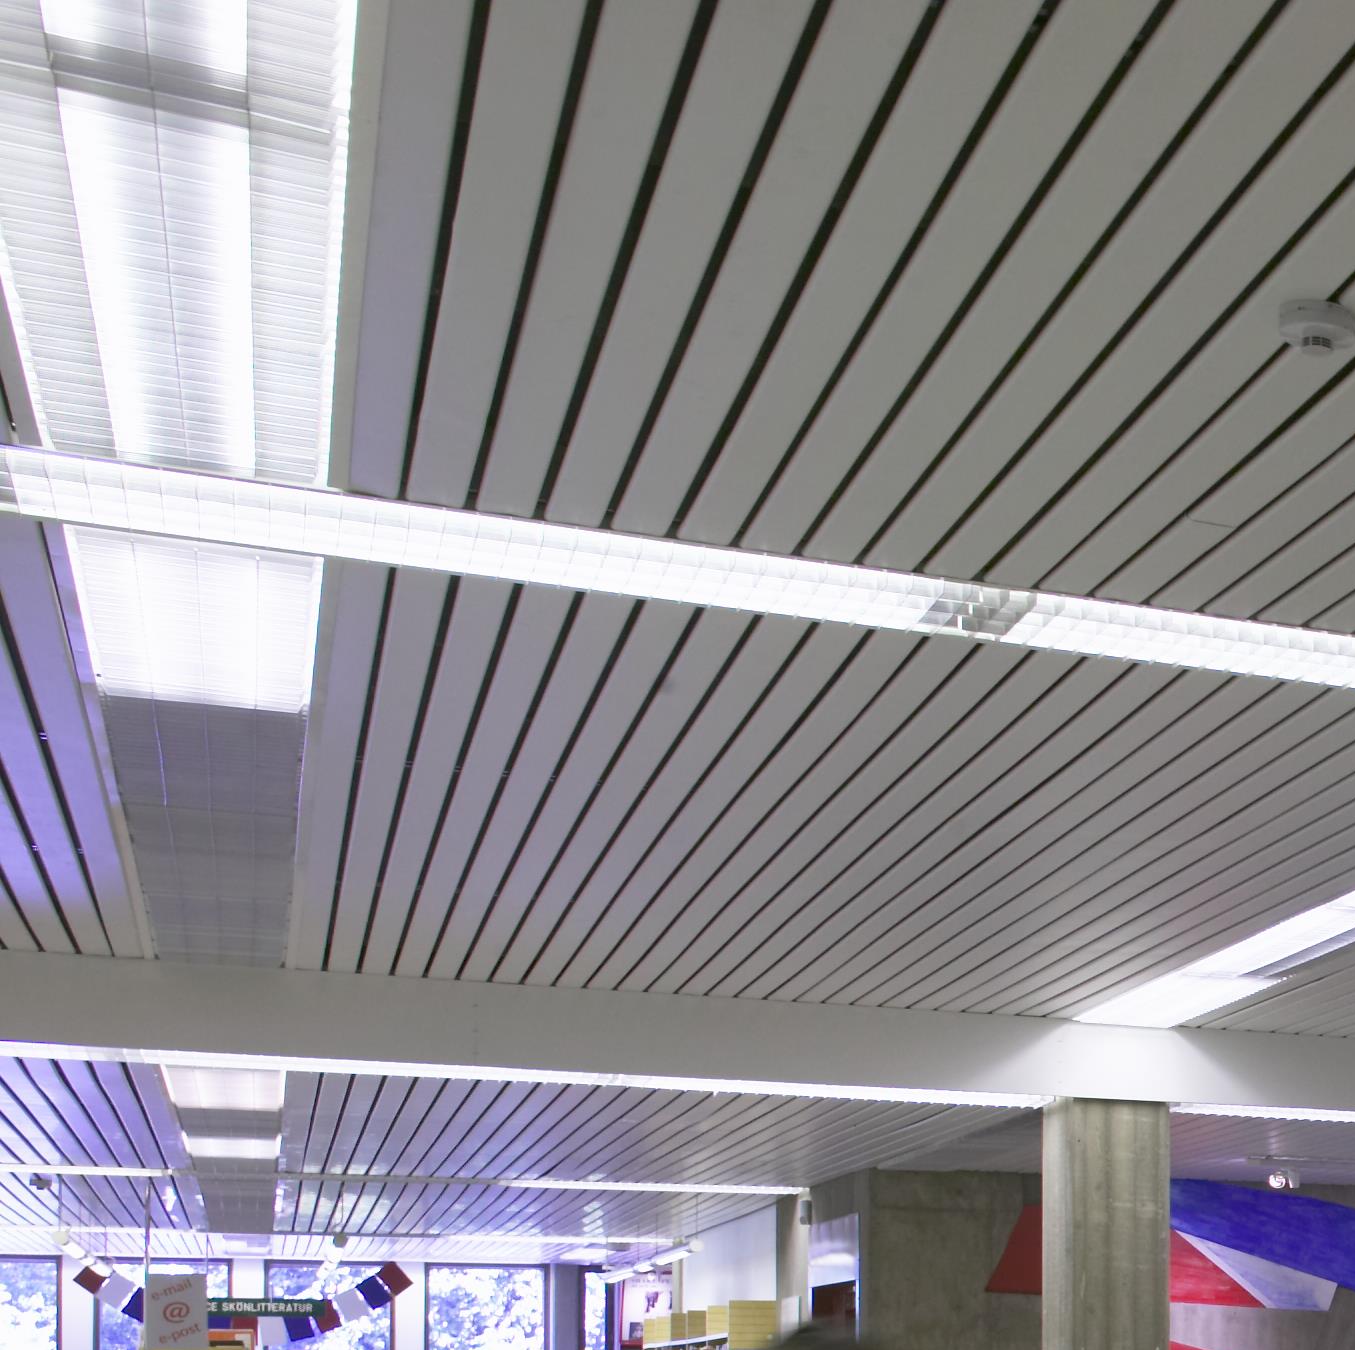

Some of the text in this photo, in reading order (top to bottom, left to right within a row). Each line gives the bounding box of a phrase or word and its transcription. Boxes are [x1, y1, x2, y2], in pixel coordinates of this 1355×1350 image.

[151, 1279, 193, 1300] e-mail
[221, 1301, 313, 1313] SKÖNLITTERATUR
[158, 1323, 200, 1345] e-post
